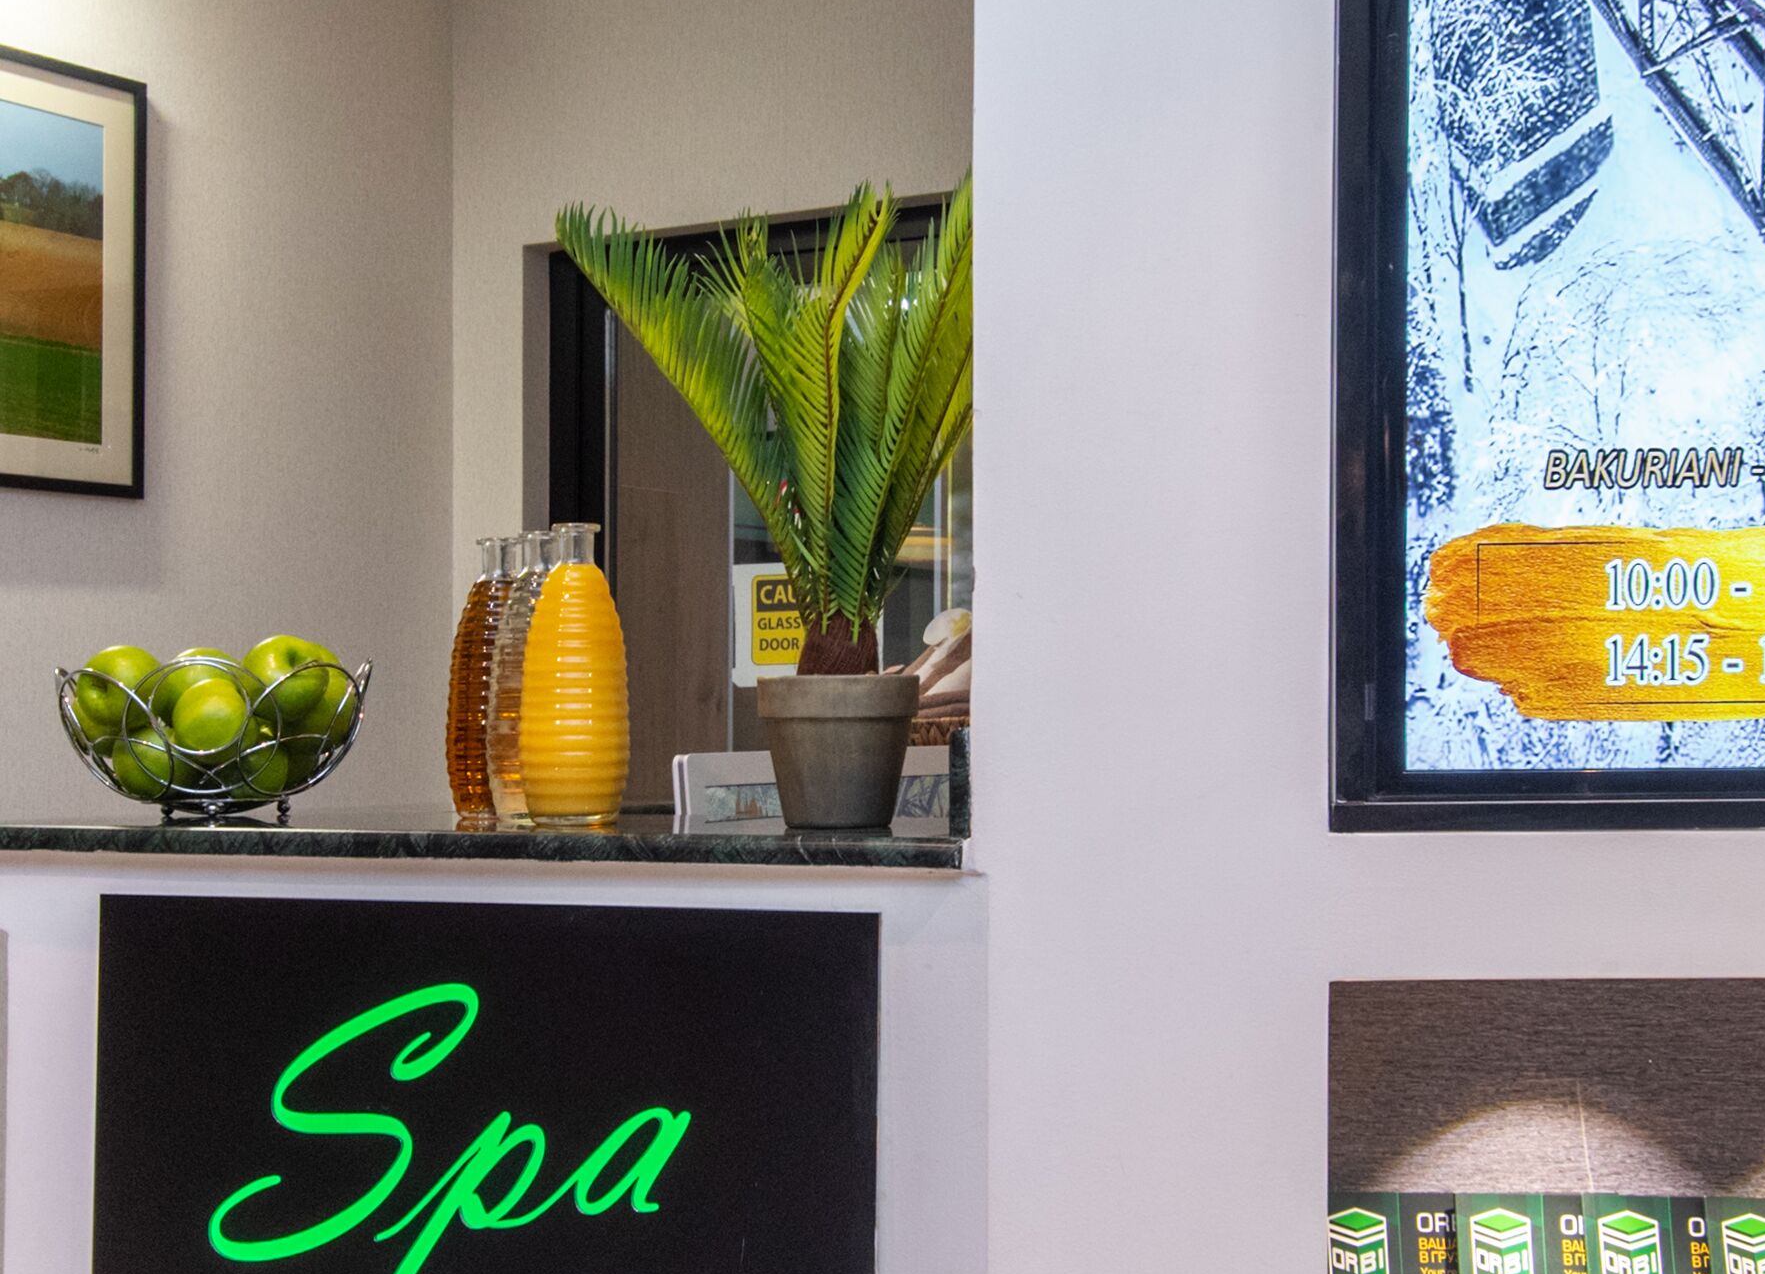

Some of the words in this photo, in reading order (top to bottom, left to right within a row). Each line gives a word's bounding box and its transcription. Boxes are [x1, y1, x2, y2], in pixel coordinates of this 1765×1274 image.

[1544, 447, 1744, 489] BAKURIANI
[1605, 558, 1719, 609] 10:00
[757, 616, 801, 630] GLASS
[759, 637, 800, 651] DOOR
[1605, 633, 1710, 686] 14:15
[1332, 1247, 1384, 1274] ORBI
